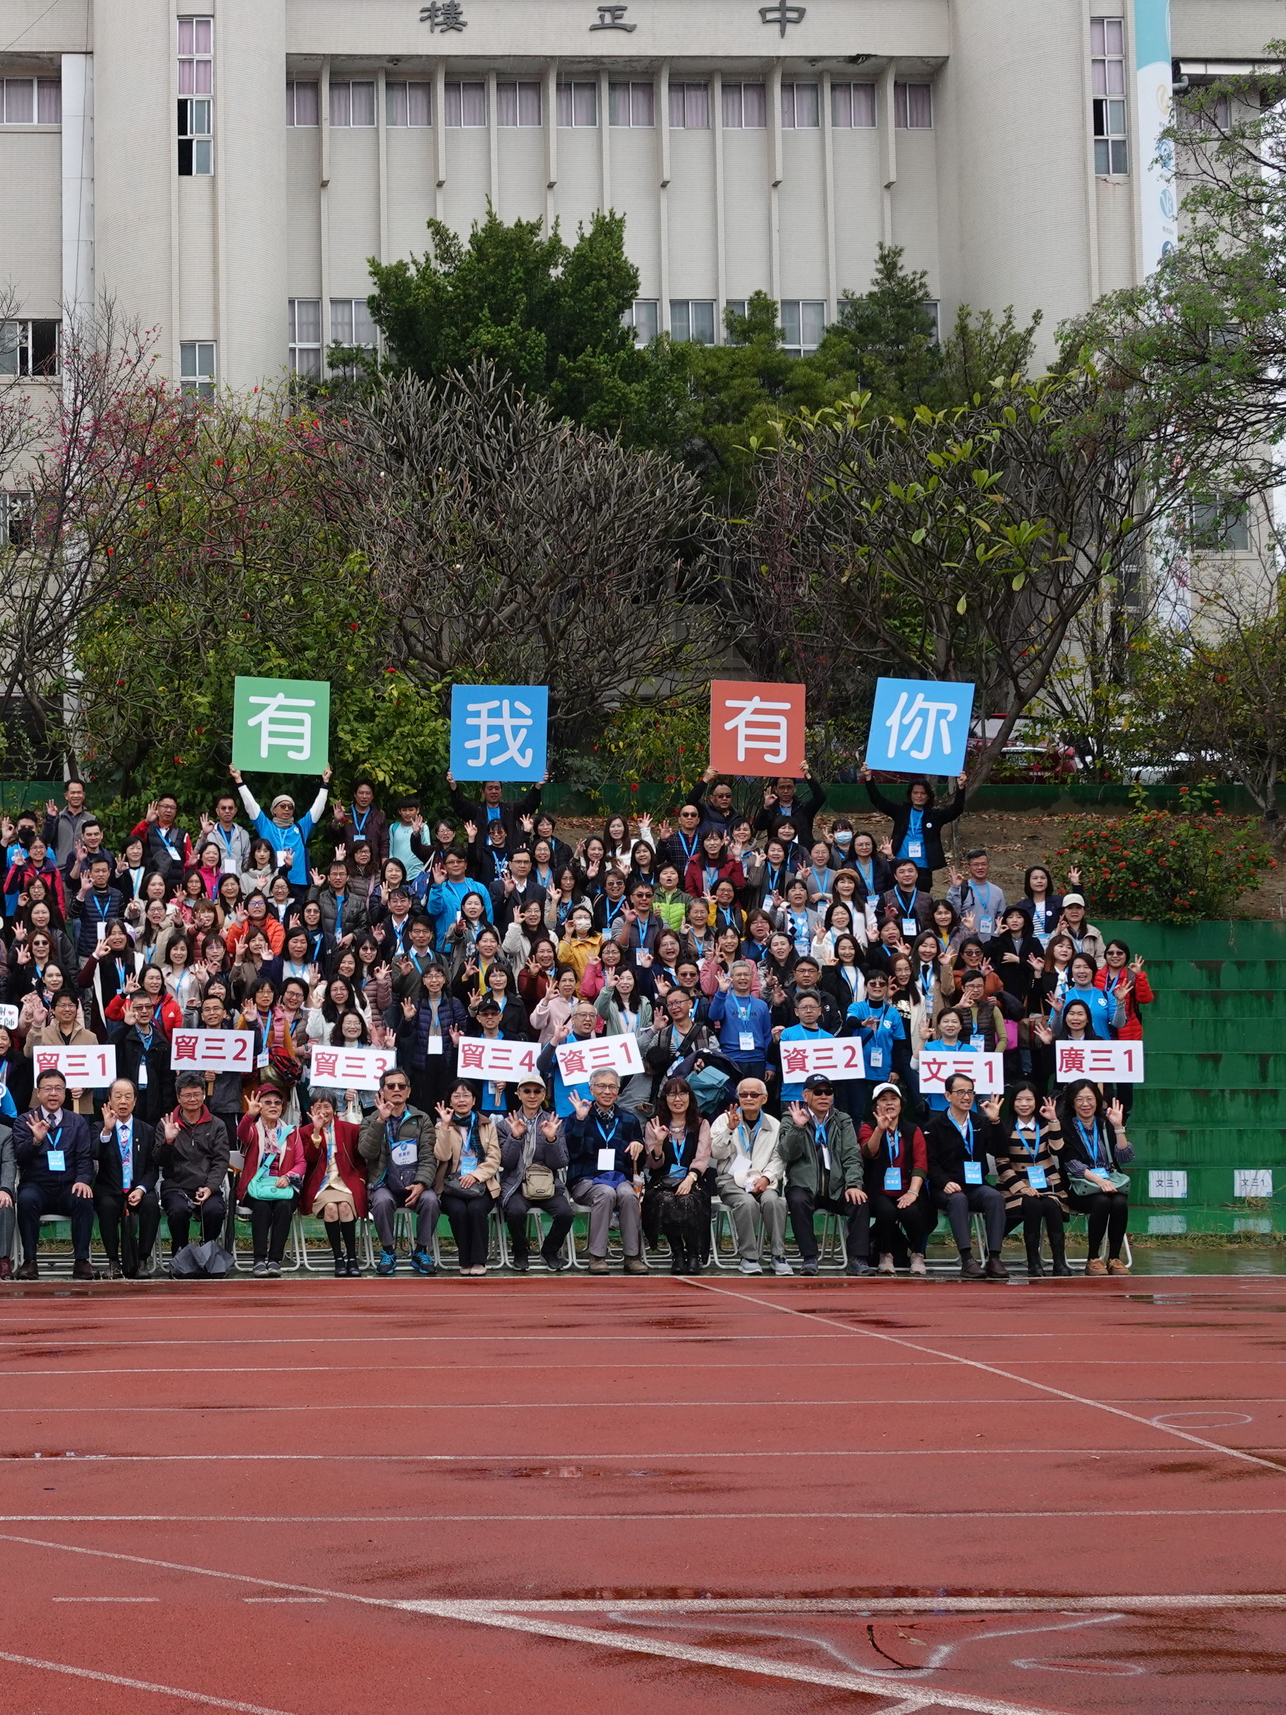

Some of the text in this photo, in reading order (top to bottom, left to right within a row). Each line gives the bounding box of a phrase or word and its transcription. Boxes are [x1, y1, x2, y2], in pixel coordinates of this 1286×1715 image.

[247, 692, 316, 761] 有
[464, 699, 533, 768] 我
[724, 695, 791, 764] 有
[885, 692, 957, 760] 你
[174, 1035, 247, 1061] 貿三2
[461, 1043, 535, 1072] 貿三4
[560, 1042, 632, 1077] 資三1
[783, 1046, 859, 1074] 資三2
[1058, 1047, 1133, 1073] 廣三1
[36, 1052, 107, 1077] 貿三1
[314, 1052, 387, 1080] 貿三3
[921, 1058, 994, 1083] 文三1
